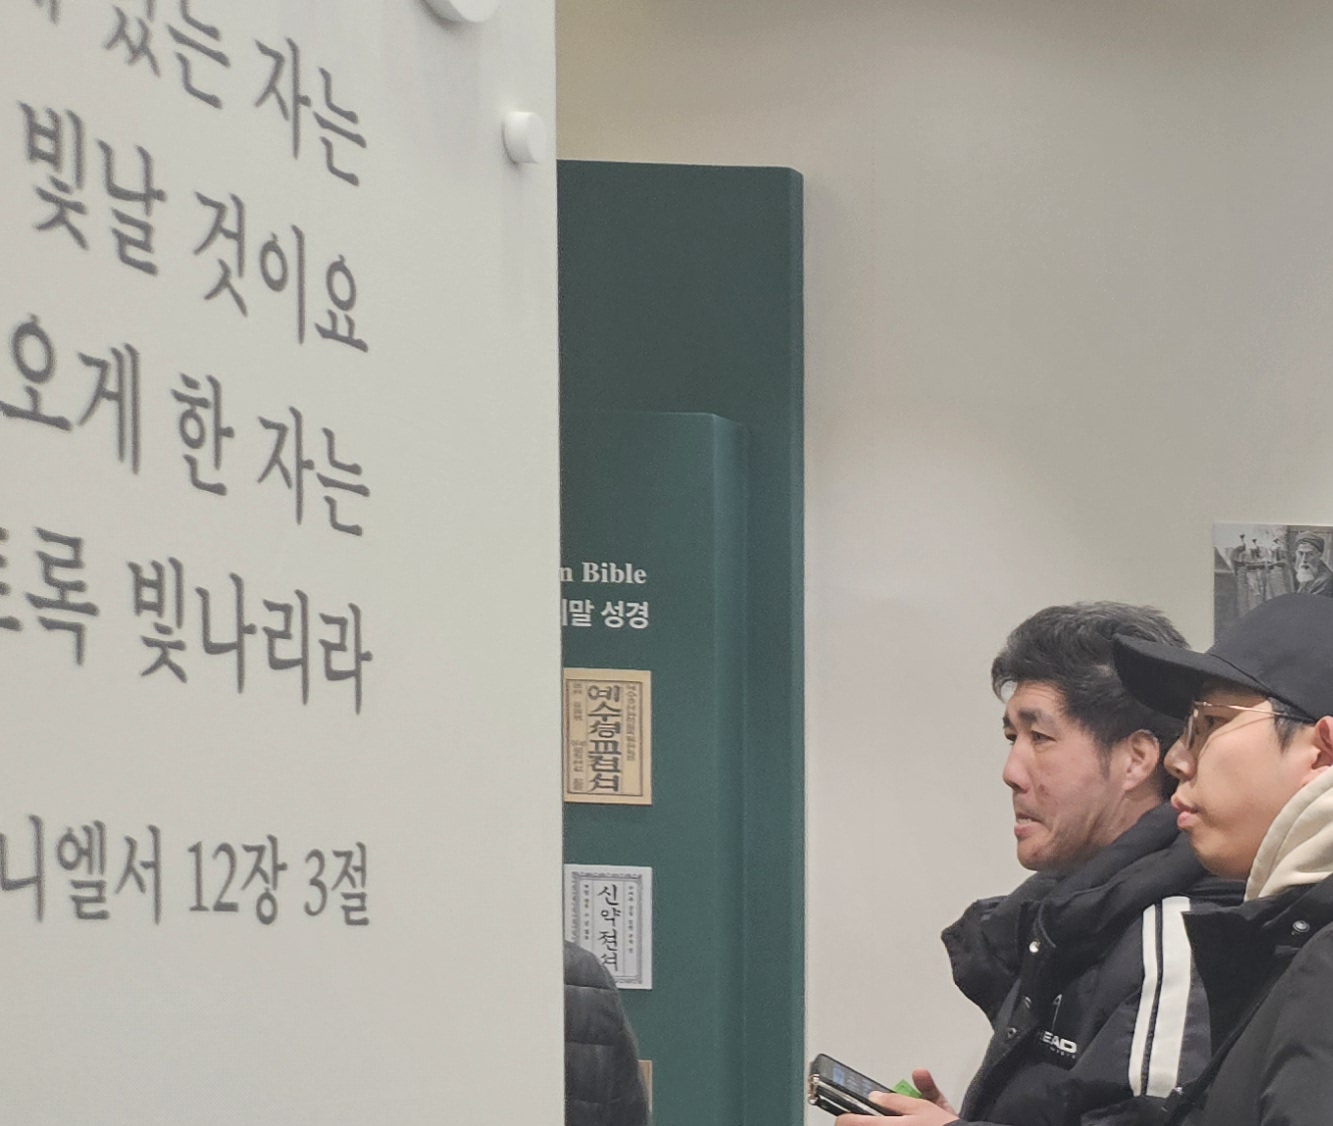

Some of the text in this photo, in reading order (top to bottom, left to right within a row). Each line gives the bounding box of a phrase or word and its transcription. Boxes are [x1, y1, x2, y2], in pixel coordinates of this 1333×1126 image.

[254, 37, 368, 187] 자는
[17, 100, 369, 354] 빛날 것이요
[0, 313, 371, 537] 오게 한 자는
[581, 561, 648, 584] Bible
[600, 600, 649, 630] 성경
[127, 556, 373, 716] 빛나리라
[187, 833, 288, 926] 12장
[303, 841, 370, 926] 3절
[1042, 1030, 1078, 1054] EAD
